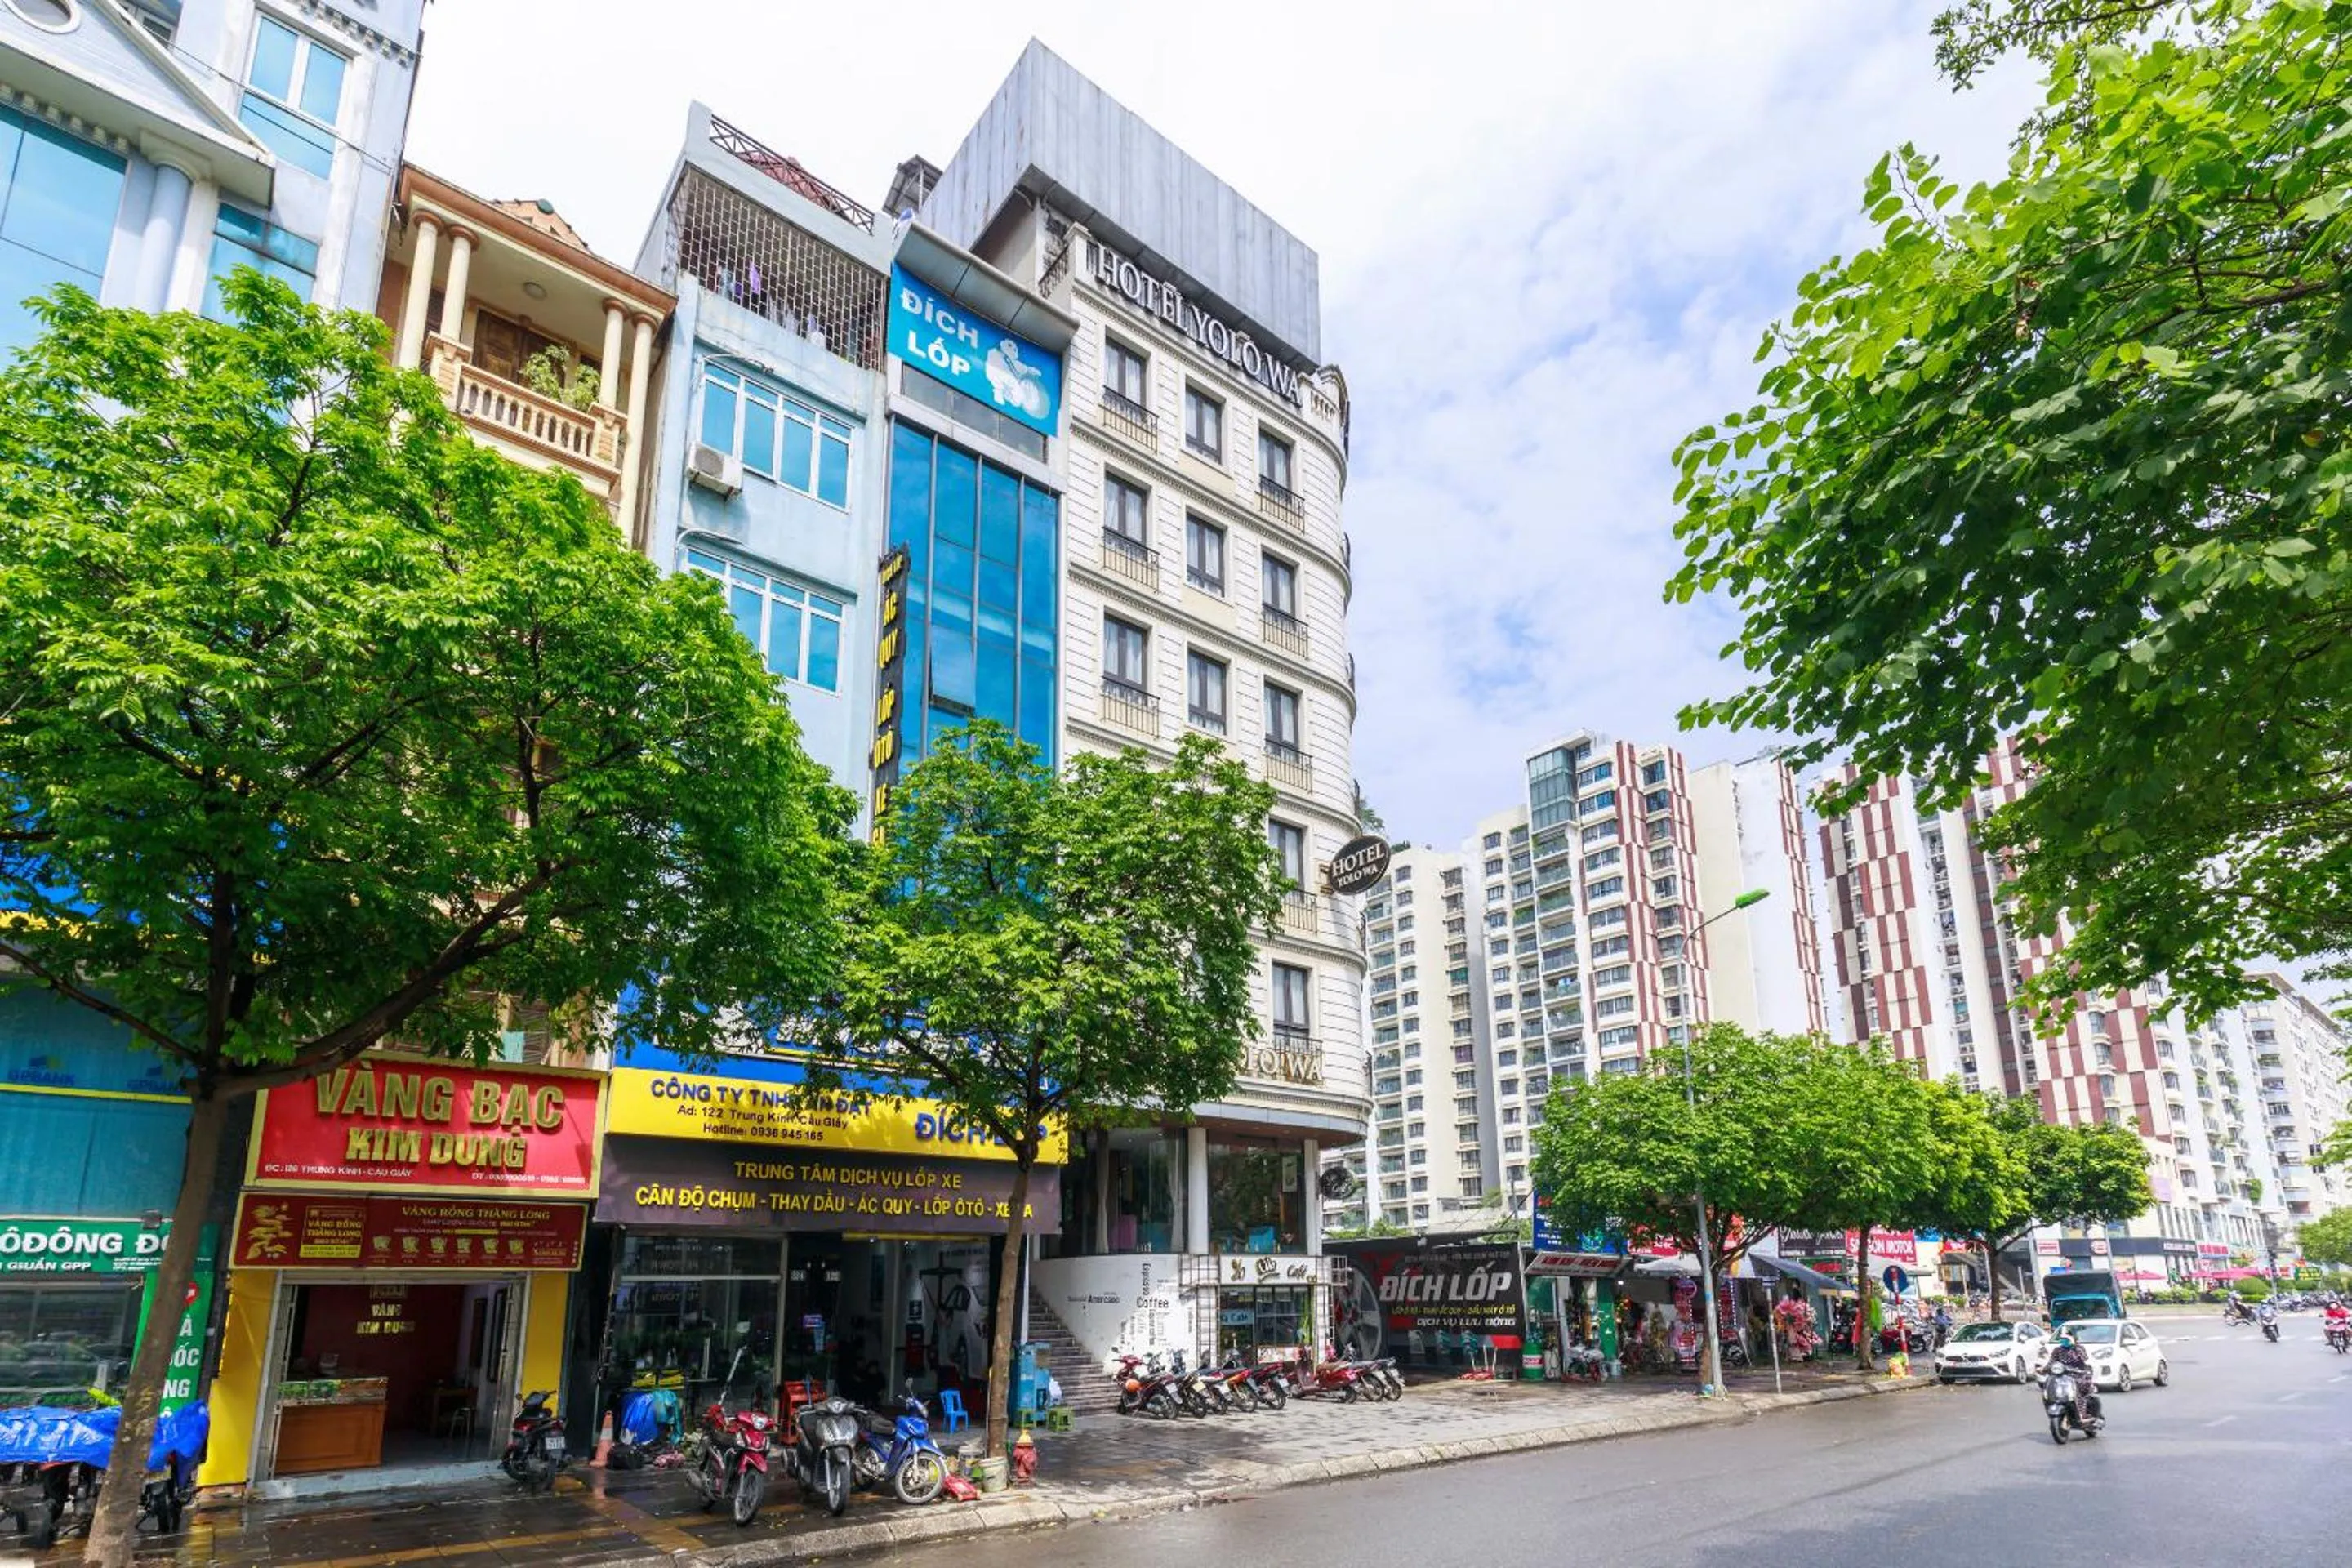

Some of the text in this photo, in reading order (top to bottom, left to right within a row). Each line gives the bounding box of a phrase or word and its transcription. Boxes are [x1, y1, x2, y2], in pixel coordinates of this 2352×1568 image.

[1097, 243, 1187, 332] HOTEL
[901, 287, 978, 349] ĐÍCH
[907, 329, 970, 376] LỐP
[1333, 842, 1385, 877] HOTEL
[315, 1060, 566, 1136] VÀNG BẠC
[651, 1076, 711, 1102] CÔNG
[716, 1085, 744, 1104] TY
[677, 1104, 697, 1116] Ad:
[702, 1107, 724, 1119] 122
[729, 1109, 764, 1124] Trung
[702, 1123, 747, 1137] Hotline:
[751, 1126, 778, 1138] 0936
[781, 1128, 803, 1140] 945
[345, 1127, 527, 1169] KIM DUNG
[734, 1161, 962, 1189] TRUNG TÂM DỊCH VỤ LỐP XE
[635, 1183, 674, 1206] CÂN
[678, 1185, 705, 1213] ĐỘ
[708, 1189, 755, 1213] CHỤM
[769, 1192, 811, 1210] THAY
[813, 1188, 845, 1213] DẦU
[882, 1197, 913, 1215] QUY
[924, 1192, 951, 1215] LỐP
[955, 1196, 984, 1216] ÔTÔ
[995, 1201, 1011, 1218] XE
[60, 1261, 91, 1270] GPP
[1379, 1260, 1512, 1302] ĐÍCH LỐP
[1136, 1296, 1169, 1308] Coffee
